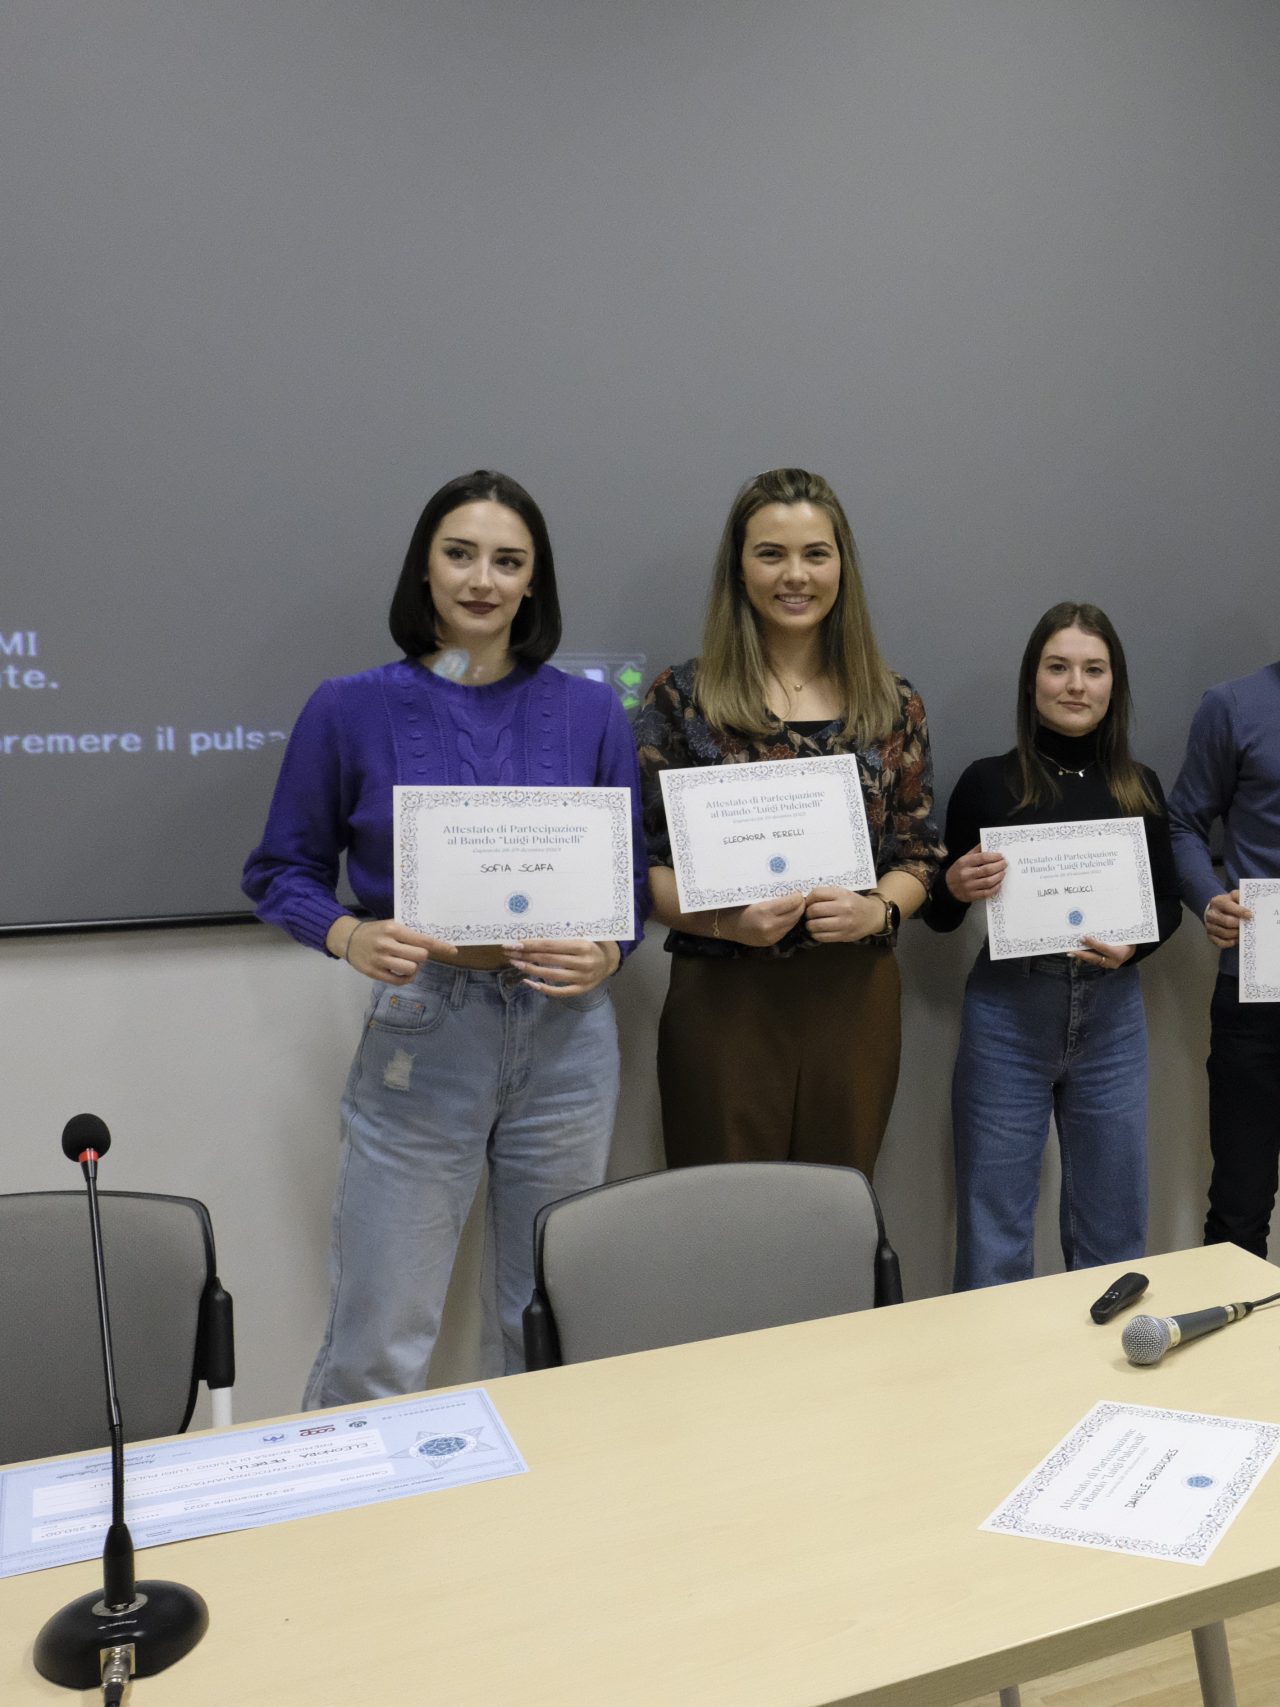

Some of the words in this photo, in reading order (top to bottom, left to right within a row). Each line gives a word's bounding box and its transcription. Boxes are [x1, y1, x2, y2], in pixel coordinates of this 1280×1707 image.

[0, 664, 59, 689] te.
[0, 732, 142, 754] remere
[156, 726, 176, 751] il
[706, 798, 748, 809] Attestato
[749, 796, 758, 804] di
[760, 790, 825, 804] Partecipazione
[710, 810, 720, 818] al
[722, 806, 750, 818] Bando
[443, 824, 494, 834] Attestato
[496, 824, 506, 834] di
[510, 824, 588, 834] Partecipazione
[723, 832, 766, 846] ELEONORA
[772, 828, 804, 840] PERELLI
[447, 836, 456, 845] al
[460, 836, 496, 845] Bando
[500, 836, 528, 846] "Luigi
[532, 835, 584, 845] Pulcinelli"
[1018, 855, 1052, 866] Attestato
[1054, 854, 1062, 862] di
[1064, 850, 1118, 862] Partecipazione
[480, 863, 512, 874] SOFIA
[518, 864, 554, 873] SCAFA
[1030, 864, 1055, 873] Bando
[1037, 887, 1058, 898] ILARIA
[1064, 884, 1094, 894] MECUCCI
[298, 1426, 336, 1437] coop
[298, 1442, 368, 1459] ELEONORA
[1057, 1480, 1092, 1509] Attestato
[1090, 1428, 1138, 1471] Partecipazione
[1081, 1481, 1107, 1501] Bando
[1123, 1483, 1152, 1507] DANIELE
